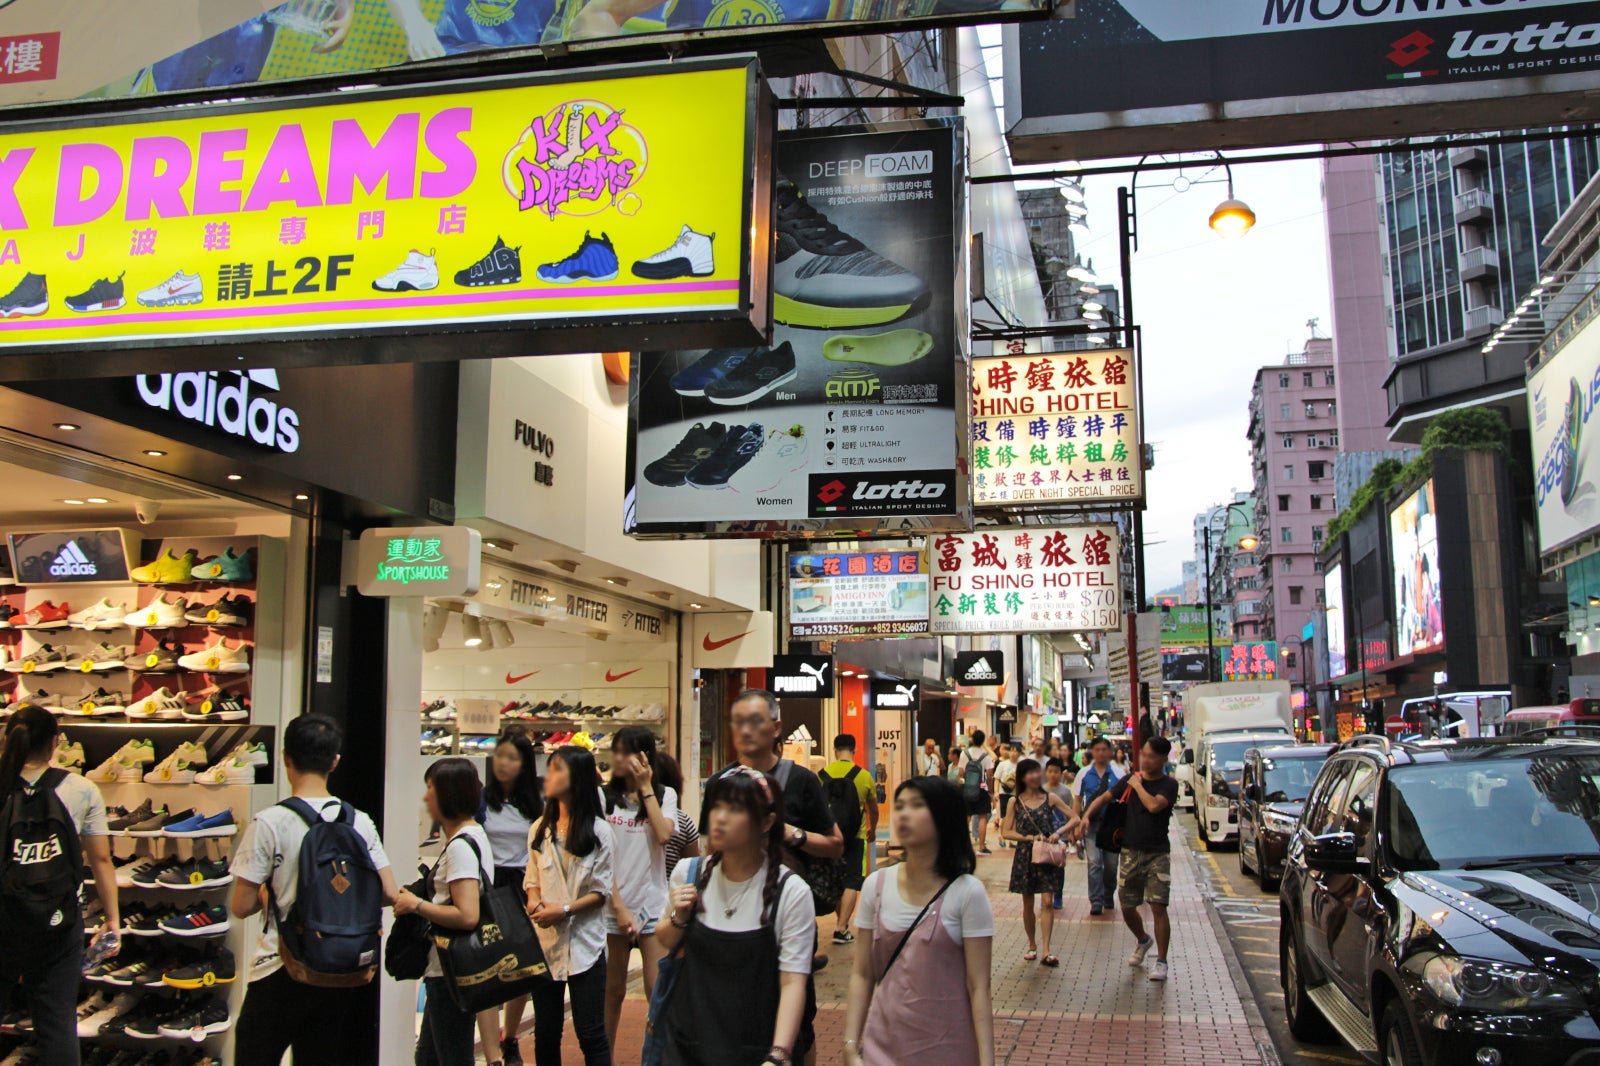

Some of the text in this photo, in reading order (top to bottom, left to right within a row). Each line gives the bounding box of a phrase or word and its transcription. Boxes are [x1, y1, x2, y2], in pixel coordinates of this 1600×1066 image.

[0, 40, 43, 75] 樓
[1448, 65, 1501, 75] ITALIAN
[1507, 59, 1553, 70] SPORT
[53, 107, 477, 227] DREAMS
[809, 154, 929, 179] DEEP FOAM
[217, 254, 354, 301] 請上2F
[776, 391, 797, 400] Men
[825, 378, 881, 397] AMF
[136, 368, 300, 453] adidas
[1047, 391, 1129, 413] HOTEL
[896, 408, 925, 416] MEMORY
[514, 418, 554, 458] FULVO
[860, 425, 885, 433] FIT&GO
[860, 440, 901, 448] ULTRALIGHT
[867, 456, 907, 464] WASH&DRY
[852, 480, 946, 500] lotto
[1012, 488, 1035, 500] OVER
[1039, 486, 1064, 499] NIGHT
[1067, 485, 1105, 497] SPECIAL
[1110, 484, 1136, 495] PRICE
[756, 496, 793, 506] Women
[387, 537, 441, 556] 運動家
[934, 533, 1007, 572] 富城
[50, 560, 97, 576] adidas
[377, 562, 449, 585] SPORTSHOUSE
[933, 571, 1114, 591] FU SHING HOTEL
[835, 591, 886, 601] AMIGO INN
[934, 591, 1025, 617] 全新裝修
[1080, 588, 1115, 607] $70
[575, 597, 608, 623] FITTER
[1080, 609, 1117, 627] $150
[634, 613, 661, 636] FITTER
[812, 621, 928, 635] 23325226 +852 93456037
[934, 620, 962, 631] SPECIAL
[965, 619, 984, 631] PRICE
[964, 672, 998, 680] adidas
[878, 730, 901, 740] JUST
[13, 833, 63, 864] STAGE
